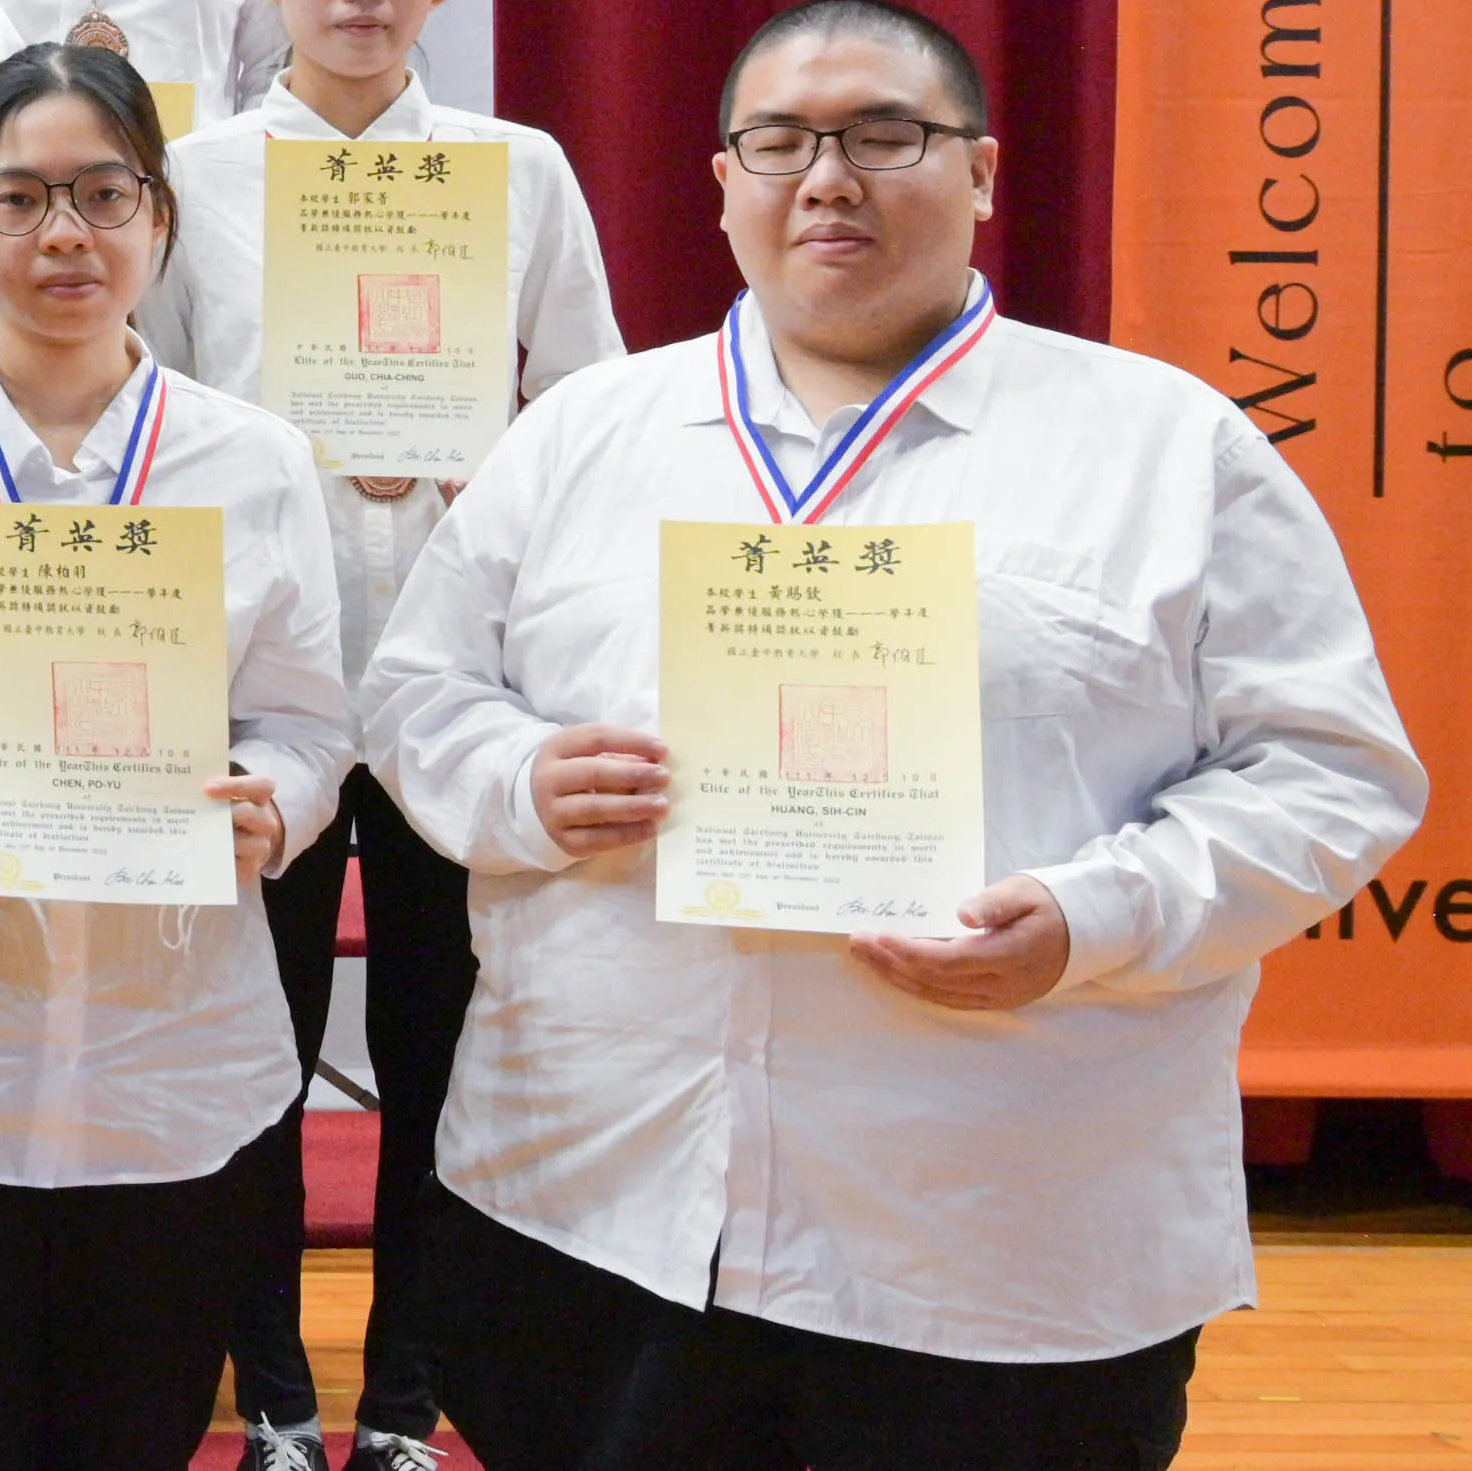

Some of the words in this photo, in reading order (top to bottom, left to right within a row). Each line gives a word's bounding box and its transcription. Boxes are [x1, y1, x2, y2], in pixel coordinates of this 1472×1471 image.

[319, 148, 450, 183] 菁英獎
[5, 513, 157, 555] 菁英獎
[731, 534, 902, 575] 菁英獎
[51, 778, 84, 789] CHEN,
[87, 779, 121, 789] PO-YU
[771, 804, 817, 815] HUANG,
[821, 806, 866, 816] SIH-CIN
[1306, 879, 1472, 943] ve
